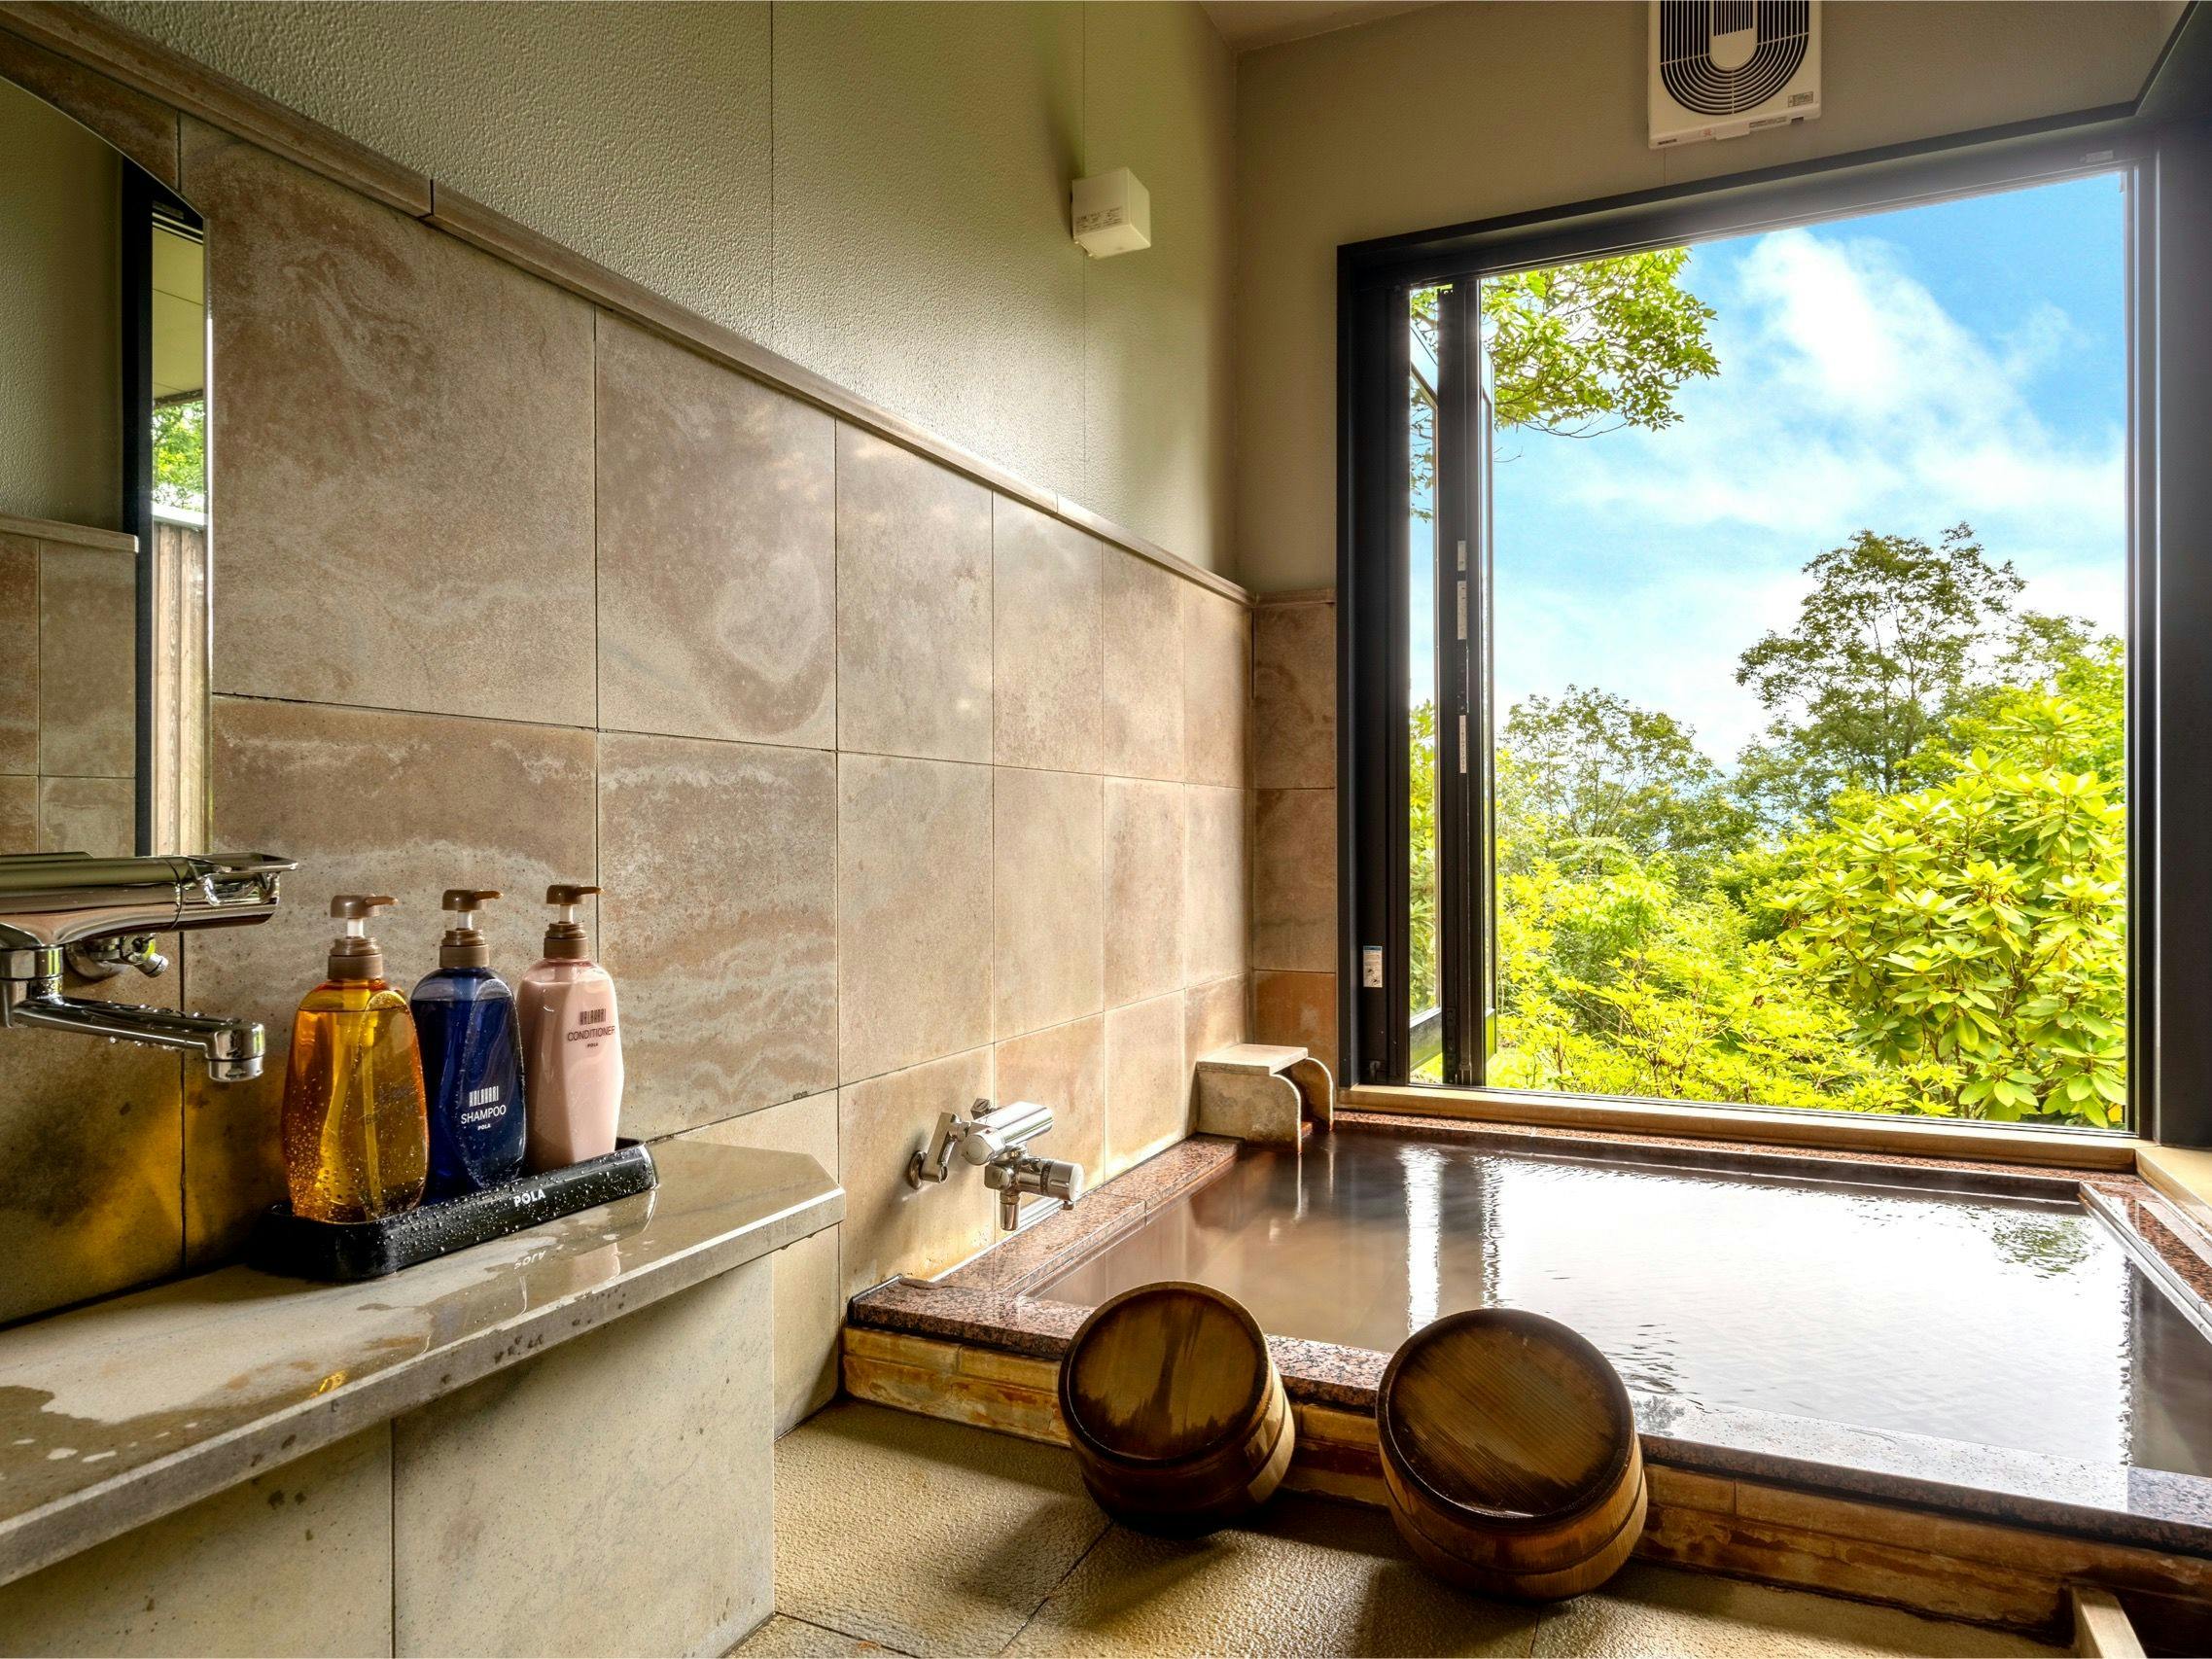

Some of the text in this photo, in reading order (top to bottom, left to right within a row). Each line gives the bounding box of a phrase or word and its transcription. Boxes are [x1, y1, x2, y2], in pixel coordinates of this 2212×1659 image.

[567, 1025, 615, 1041] CONDITIONER
[460, 1105, 507, 1124] SHAMPOO
[513, 1188, 546, 1207] POLA
